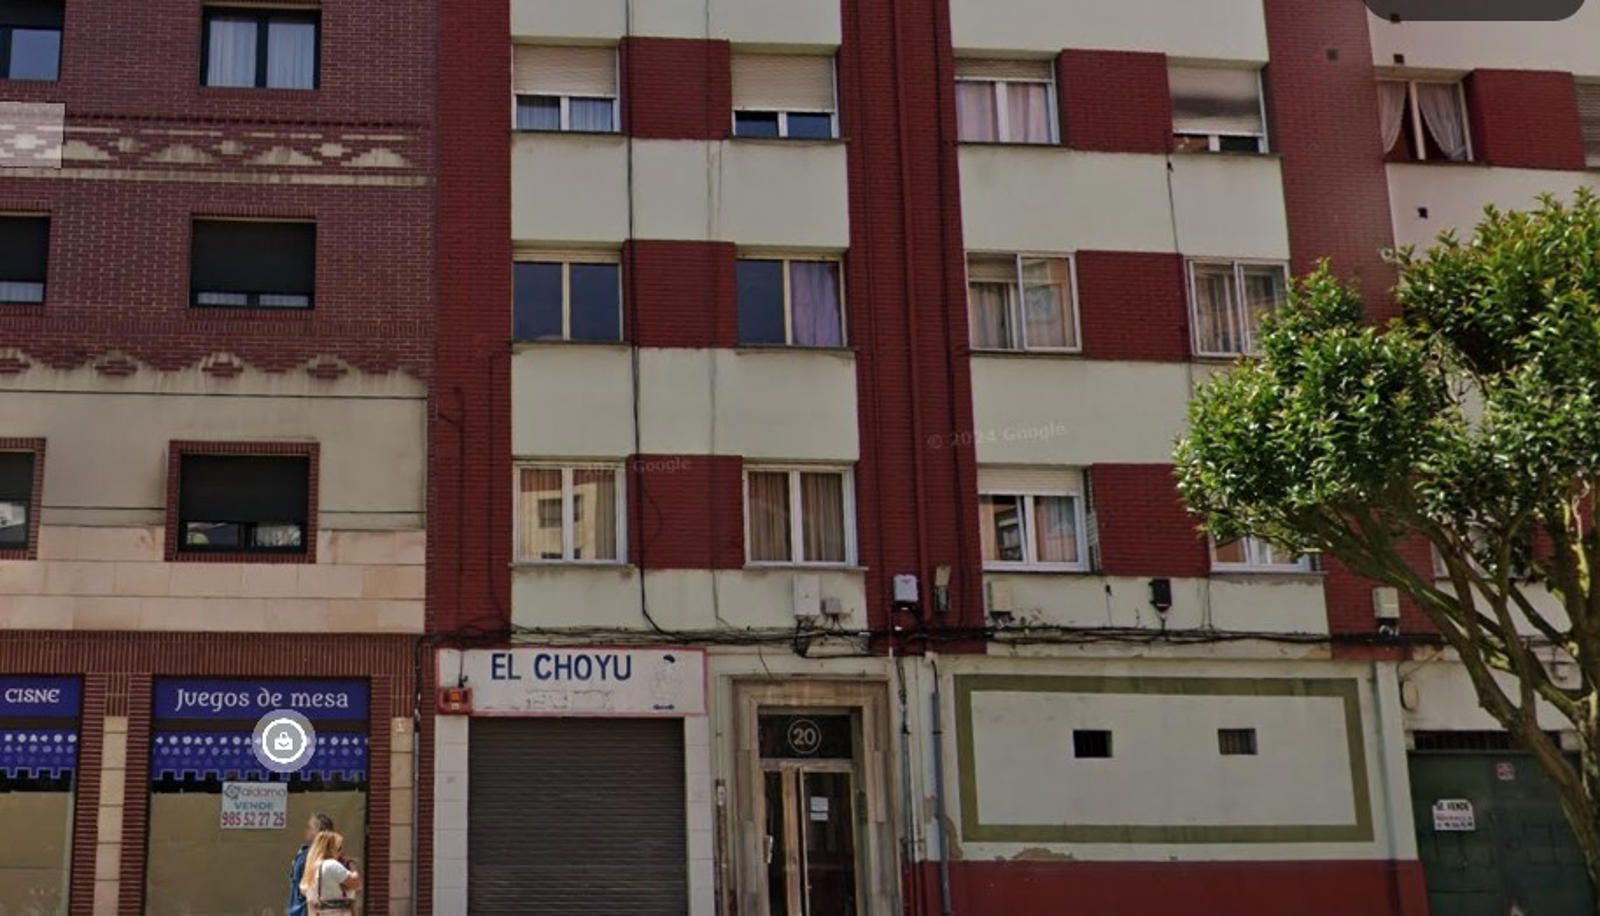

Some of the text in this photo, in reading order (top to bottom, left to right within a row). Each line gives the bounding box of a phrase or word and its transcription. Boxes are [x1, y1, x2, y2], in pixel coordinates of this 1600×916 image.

[491, 653, 632, 681] EL CHOYU
[4, 687, 61, 704] CISNE
[174, 687, 349, 713] Juegos de mesa
[792, 727, 816, 746] 20
[234, 801, 274, 810] VENDE
[222, 811, 285, 826] 985 52 27 25
